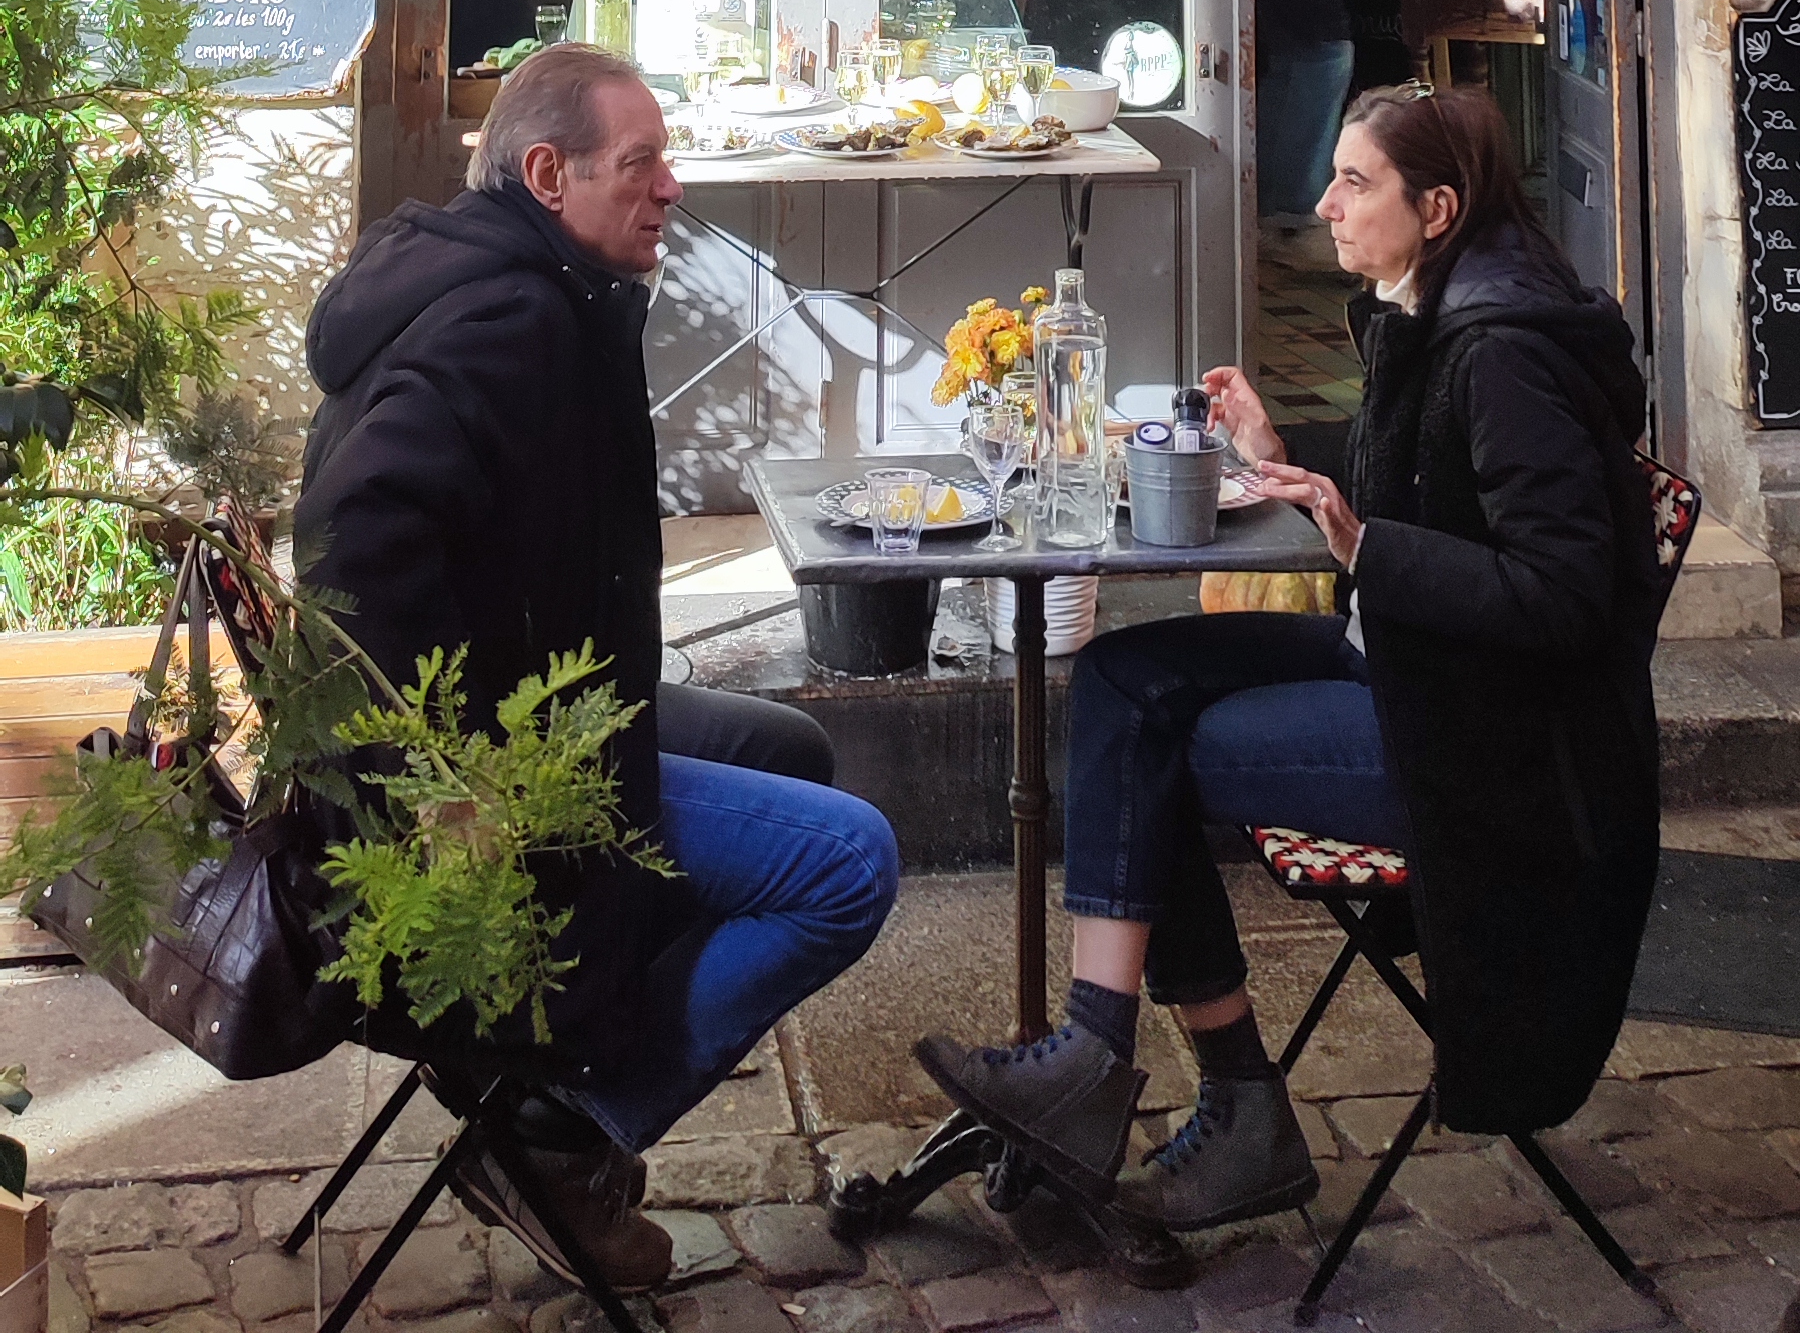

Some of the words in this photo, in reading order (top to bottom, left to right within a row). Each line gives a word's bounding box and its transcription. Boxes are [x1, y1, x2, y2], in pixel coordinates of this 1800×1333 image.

[234, 6, 258, 27] les
[260, 5, 297, 36] 100g
[195, 40, 261, 67] emporter
[1757, 72, 1796, 92] La
[1761, 109, 1798, 130] La
[1755, 151, 1790, 171] La
[1764, 188, 1800, 207] La
[1765, 229, 1798, 250] La
